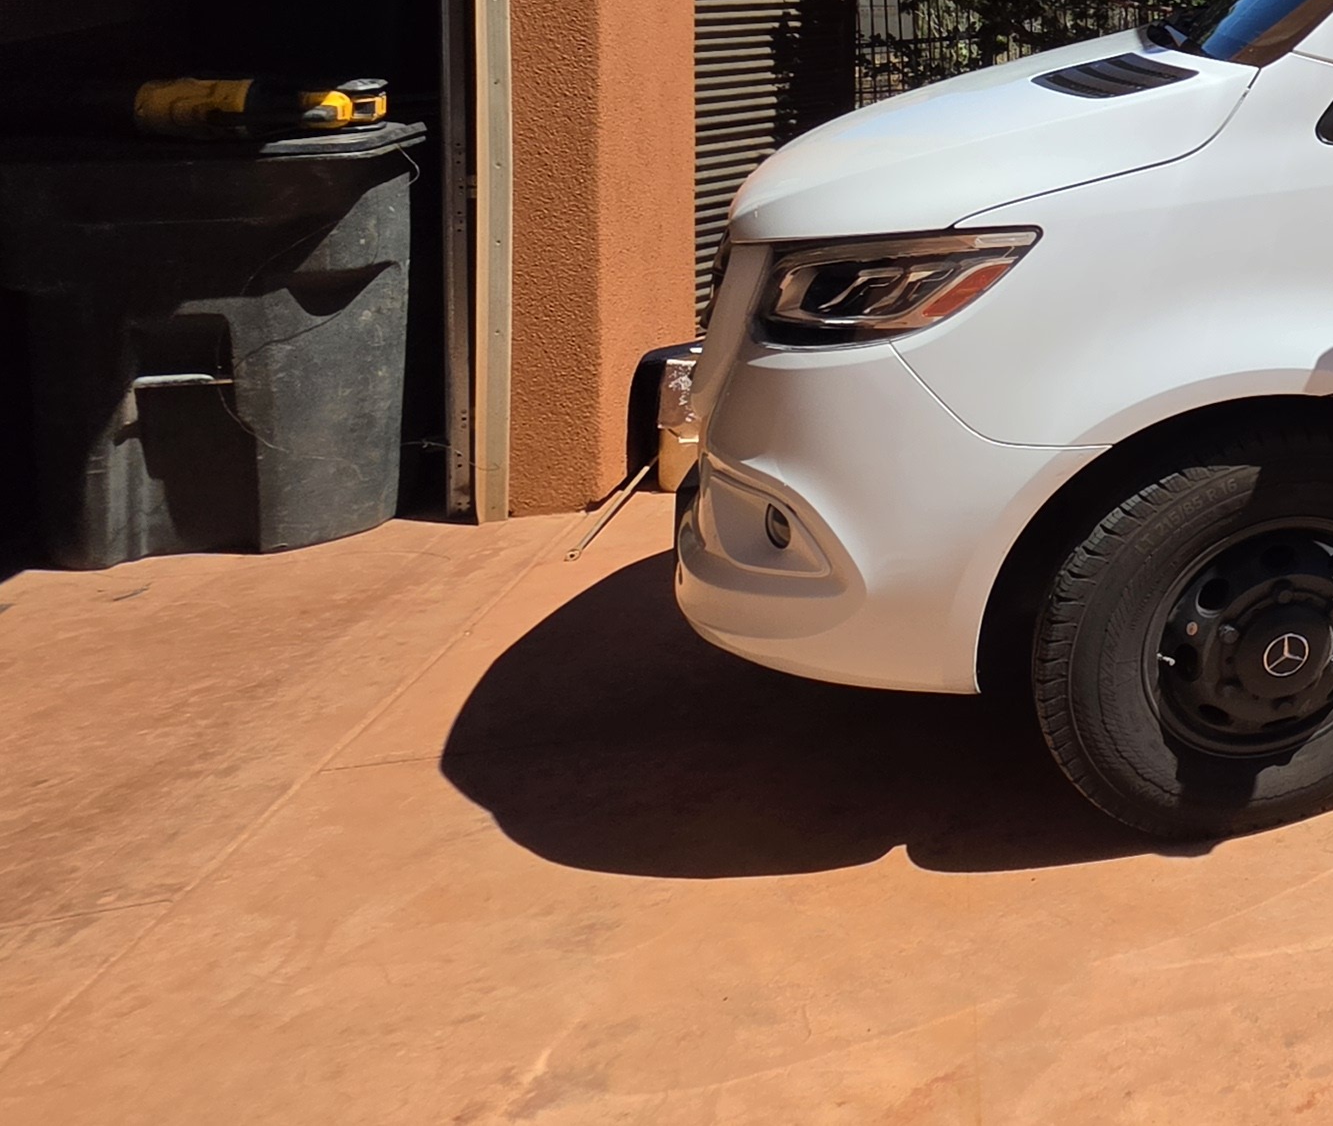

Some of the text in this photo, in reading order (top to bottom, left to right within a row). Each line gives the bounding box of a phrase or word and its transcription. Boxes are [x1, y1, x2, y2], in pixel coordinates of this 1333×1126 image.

[1134, 478, 1238, 555] LT 215/85 R 16
